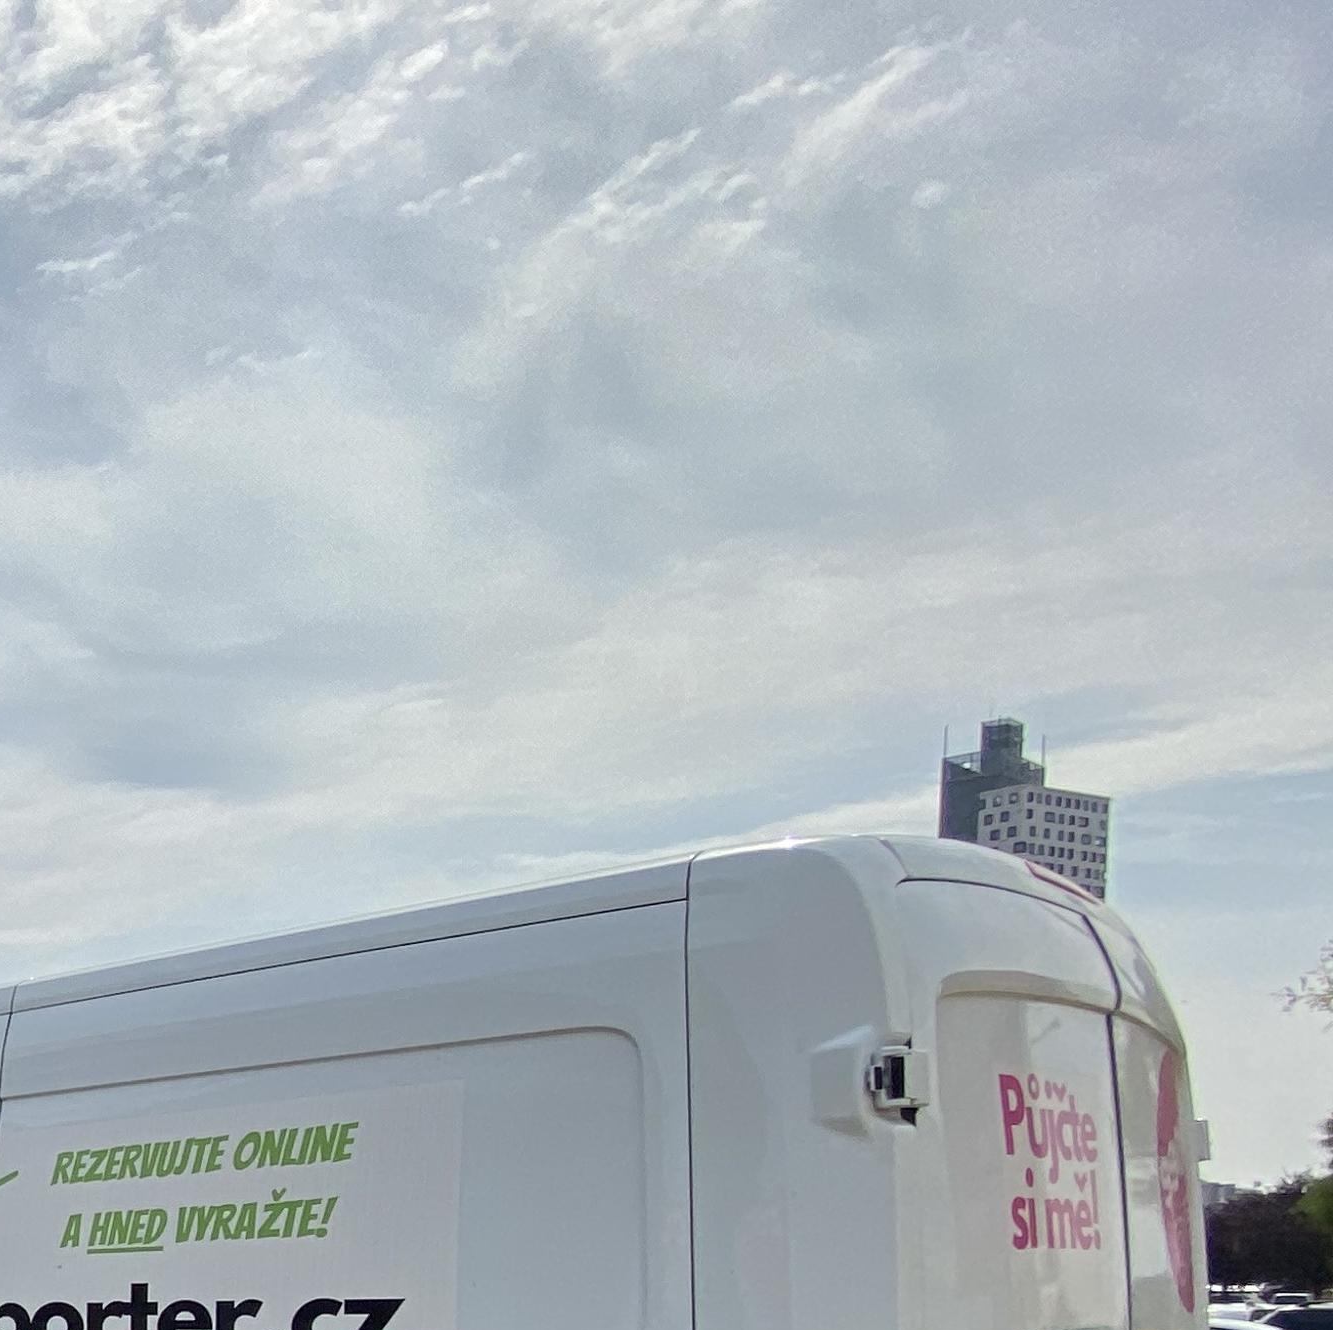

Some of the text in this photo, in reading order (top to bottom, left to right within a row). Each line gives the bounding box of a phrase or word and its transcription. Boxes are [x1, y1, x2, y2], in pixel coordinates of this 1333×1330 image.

[50, 1122, 360, 1187] REZERVUJTE ONLINE
[59, 1189, 340, 1250] A HNED VYRAŽTE!
[1012, 1167, 1101, 1250] si mě!
